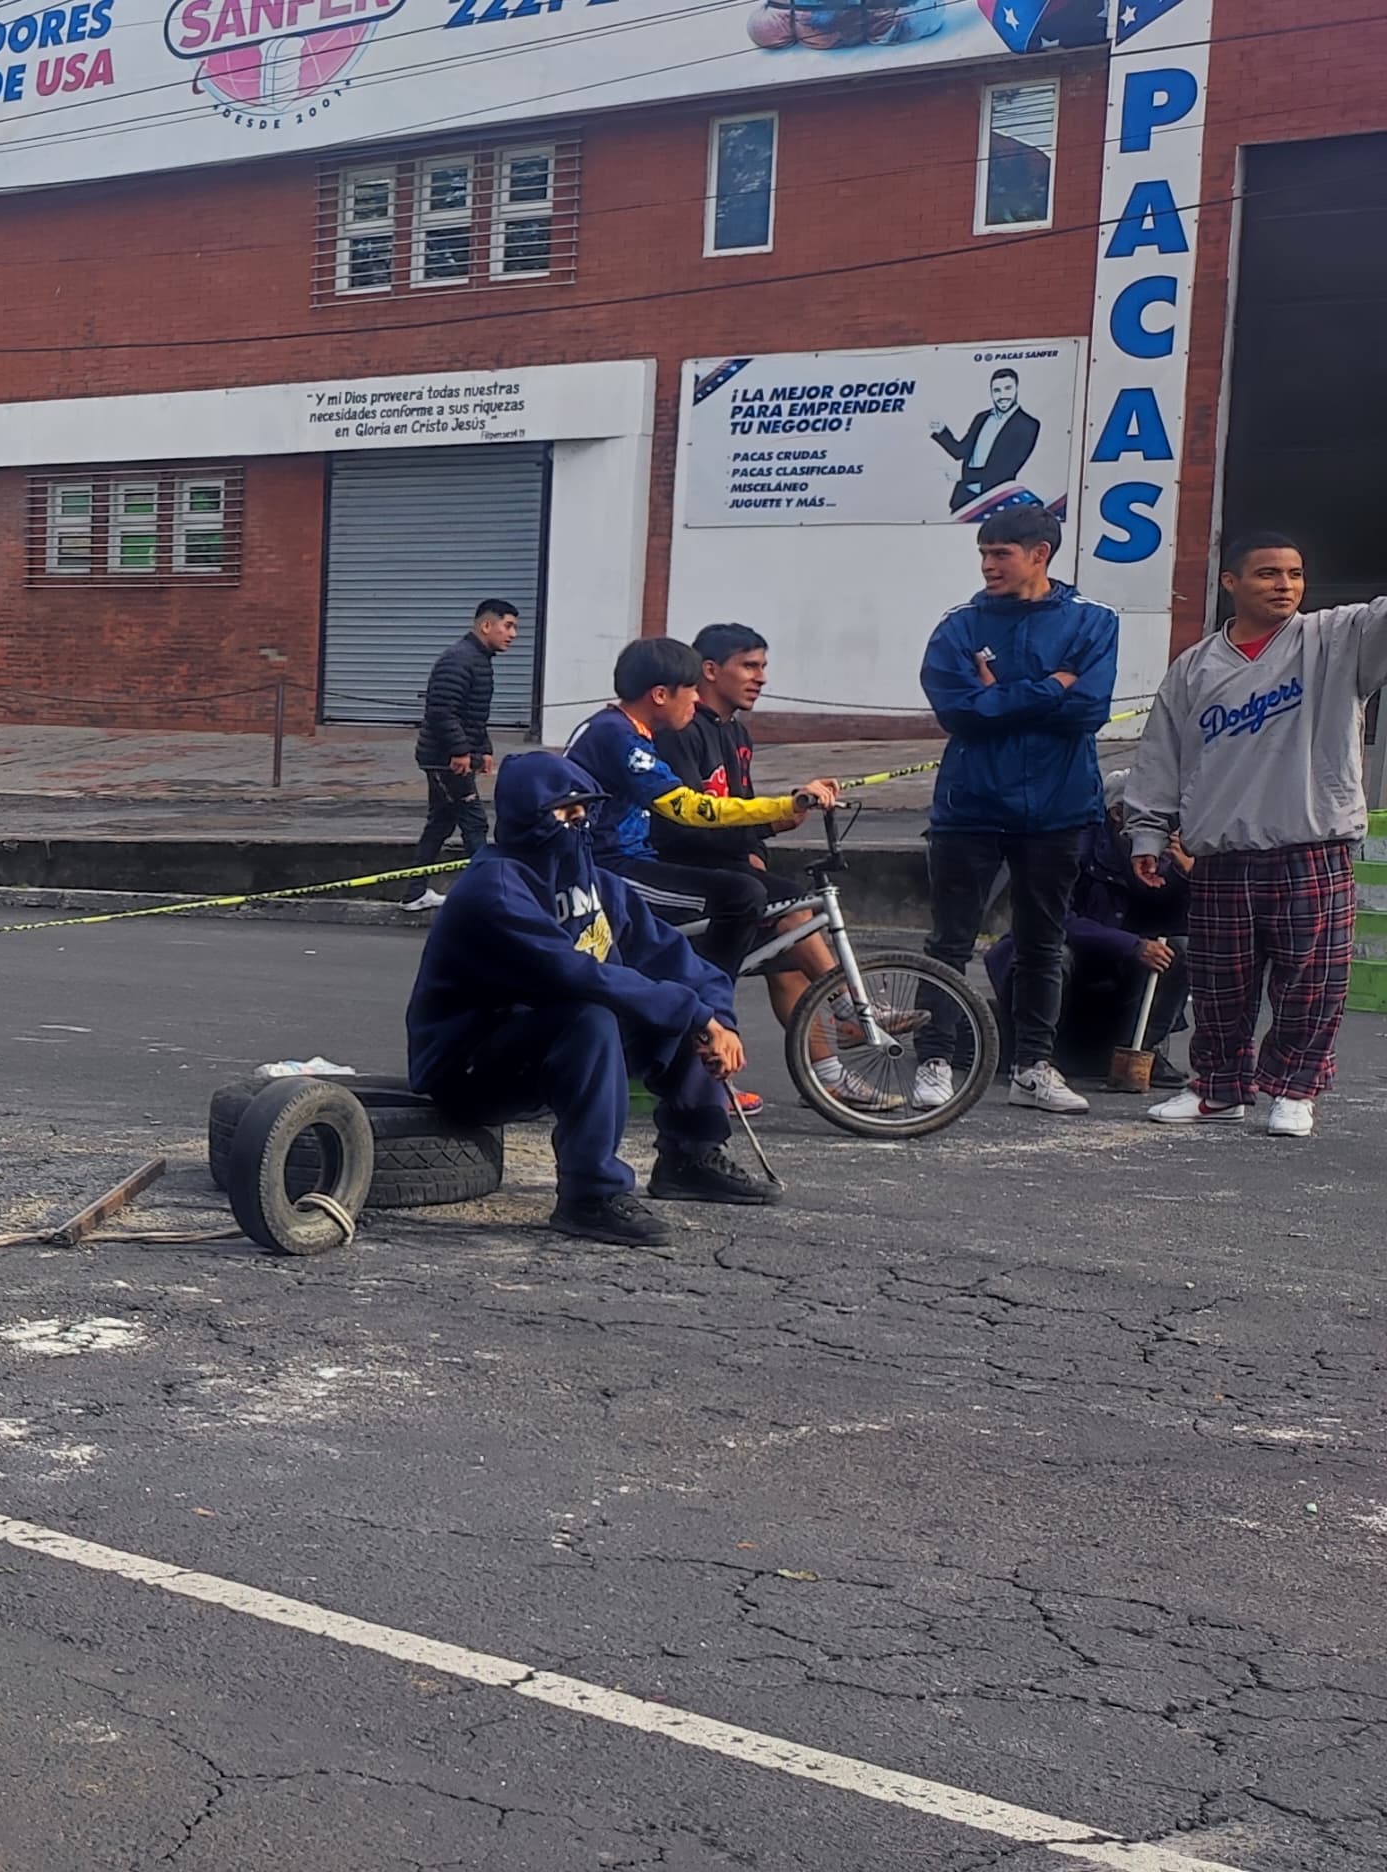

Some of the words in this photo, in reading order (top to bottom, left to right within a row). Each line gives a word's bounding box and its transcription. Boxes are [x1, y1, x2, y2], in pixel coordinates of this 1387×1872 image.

[36, 48, 115, 97] USA
[222, 107, 281, 130] DESDE
[1092, 67, 1199, 564] PACAS
[994, 351, 1024, 361] PACAS
[1024, 349, 1059, 360] SANFER
[328, 391, 342, 405] mi
[344, 390, 367, 405] Dios
[370, 386, 423, 406] proveerá
[427, 385, 461, 400] todas
[464, 382, 521, 398] nuestras
[769, 385, 834, 402] MEJOR
[839, 378, 916, 399] OPCIÓN
[309, 405, 377, 423] necesidades
[380, 403, 434, 419] conforme
[436, 406, 445, 416] a
[448, 404, 469, 415] sus
[473, 399, 525, 416] riquezas
[730, 403, 783, 420] PARA
[787, 398, 906, 417] EMPRENDER
[334, 426, 349, 438] en
[355, 421, 391, 437] Gloria
[394, 422, 408, 434] en
[411, 418, 449, 433] Cristo
[730, 421, 753, 436] TU
[732, 451, 774, 462] PACAS
[776, 450, 828, 461] CRUDAS
[731, 467, 773, 478] PACAS
[775, 465, 864, 477] CLASIFICADAS
[730, 481, 809, 493] MISCELÁNEO
[729, 498, 782, 509] JUGUETE
[784, 498, 794, 508] Y
[1199, 677, 1304, 744] Dodgers
